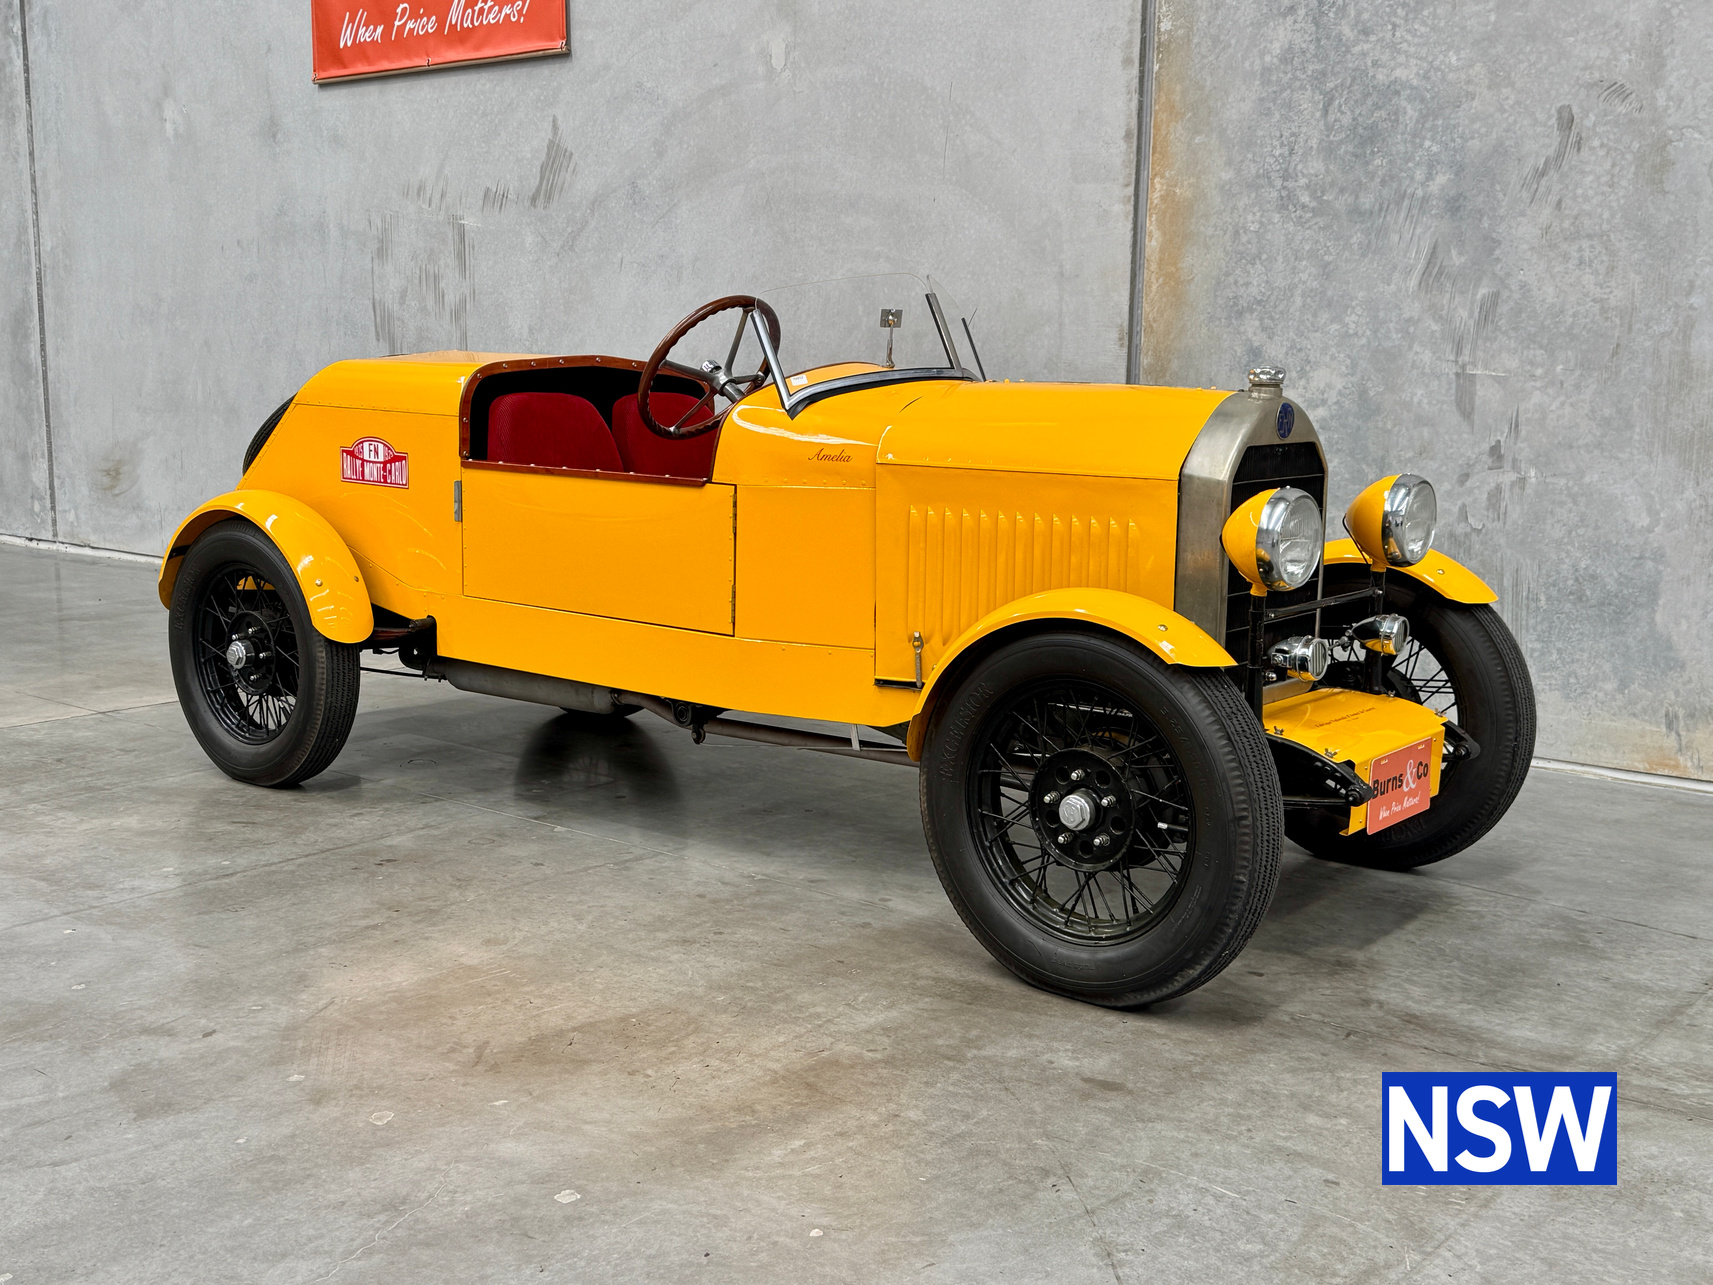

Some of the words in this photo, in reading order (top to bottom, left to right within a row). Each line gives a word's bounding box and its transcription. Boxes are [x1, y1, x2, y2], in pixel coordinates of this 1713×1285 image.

[340, 9, 384, 49] When
[391, 3, 437, 41] Price
[444, 0, 531, 35] Matters!
[368, 443, 379, 460] FN
[808, 448, 853, 463] Amelia
